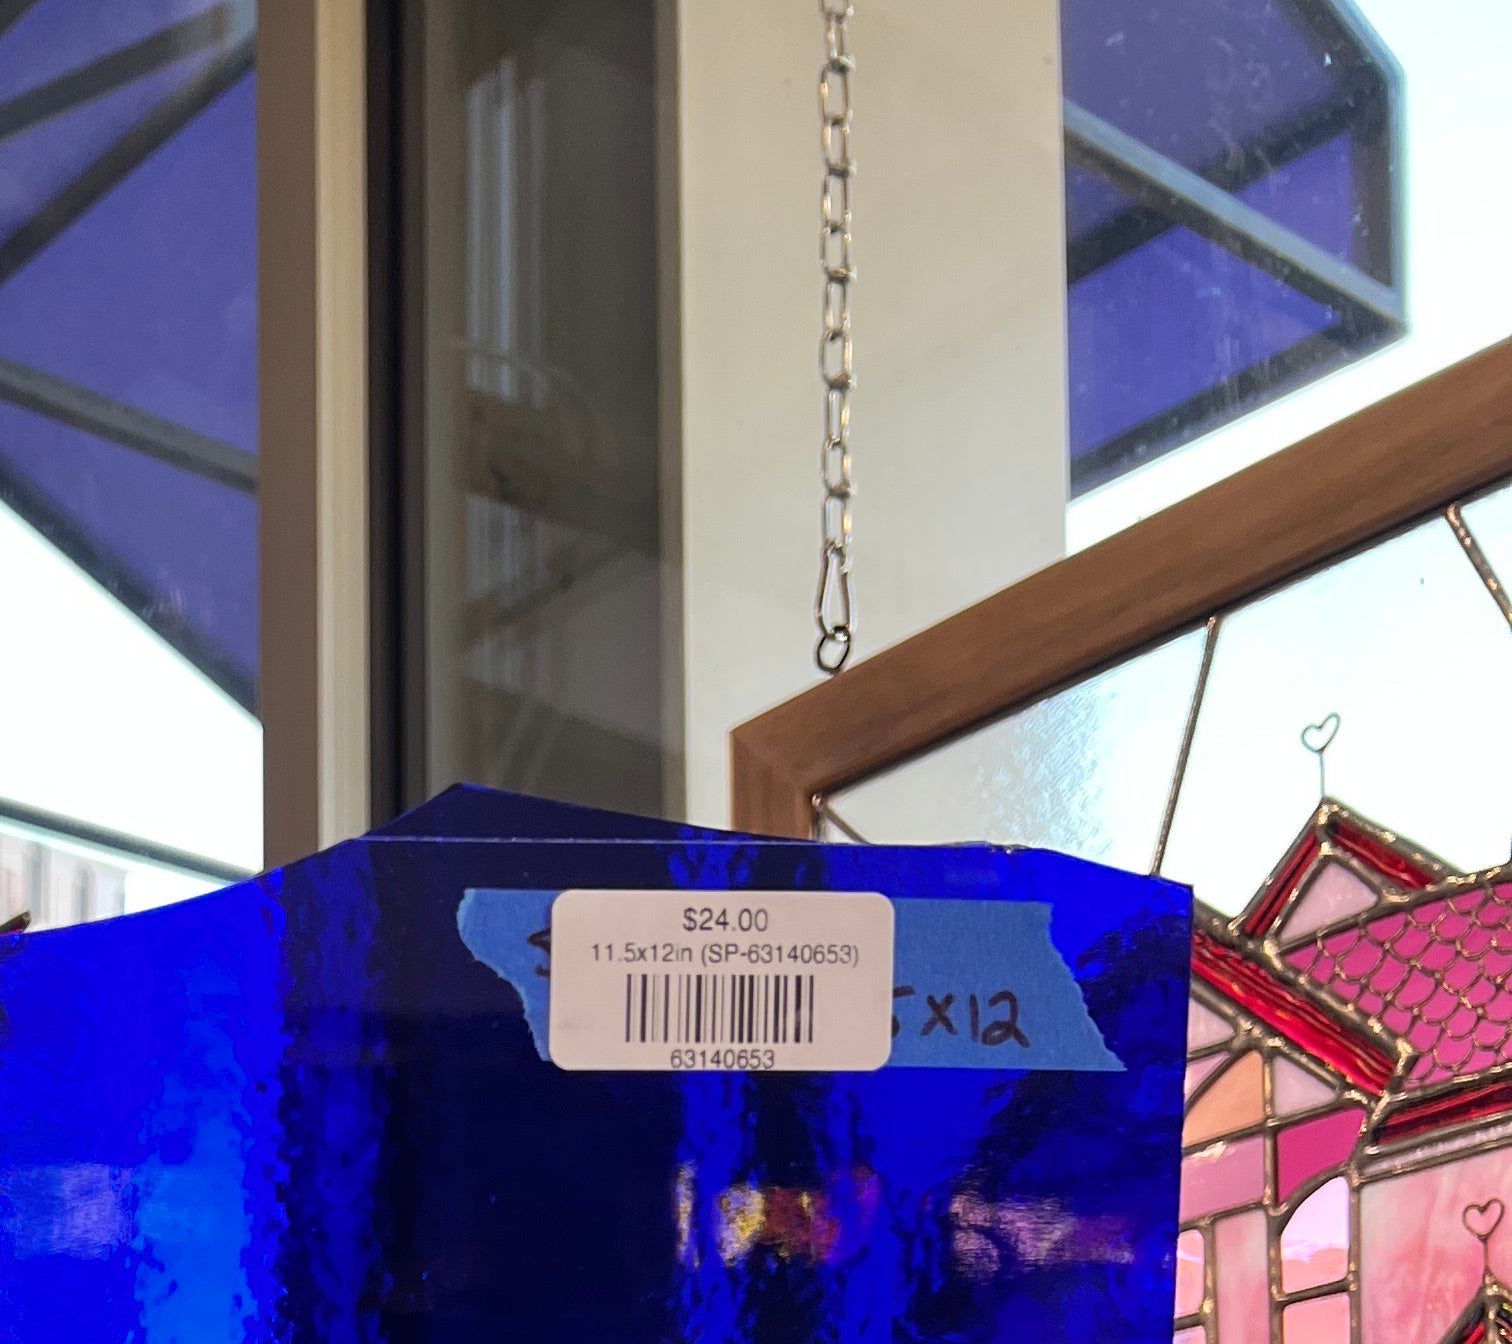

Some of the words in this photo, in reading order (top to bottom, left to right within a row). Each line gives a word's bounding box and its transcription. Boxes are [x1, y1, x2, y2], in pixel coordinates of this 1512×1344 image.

[682, 907, 769, 932] $24.00
[591, 942, 693, 963] 11.5x12in
[700, 943, 860, 968] (SP-63140653)
[670, 1048, 776, 1070] 63140653
